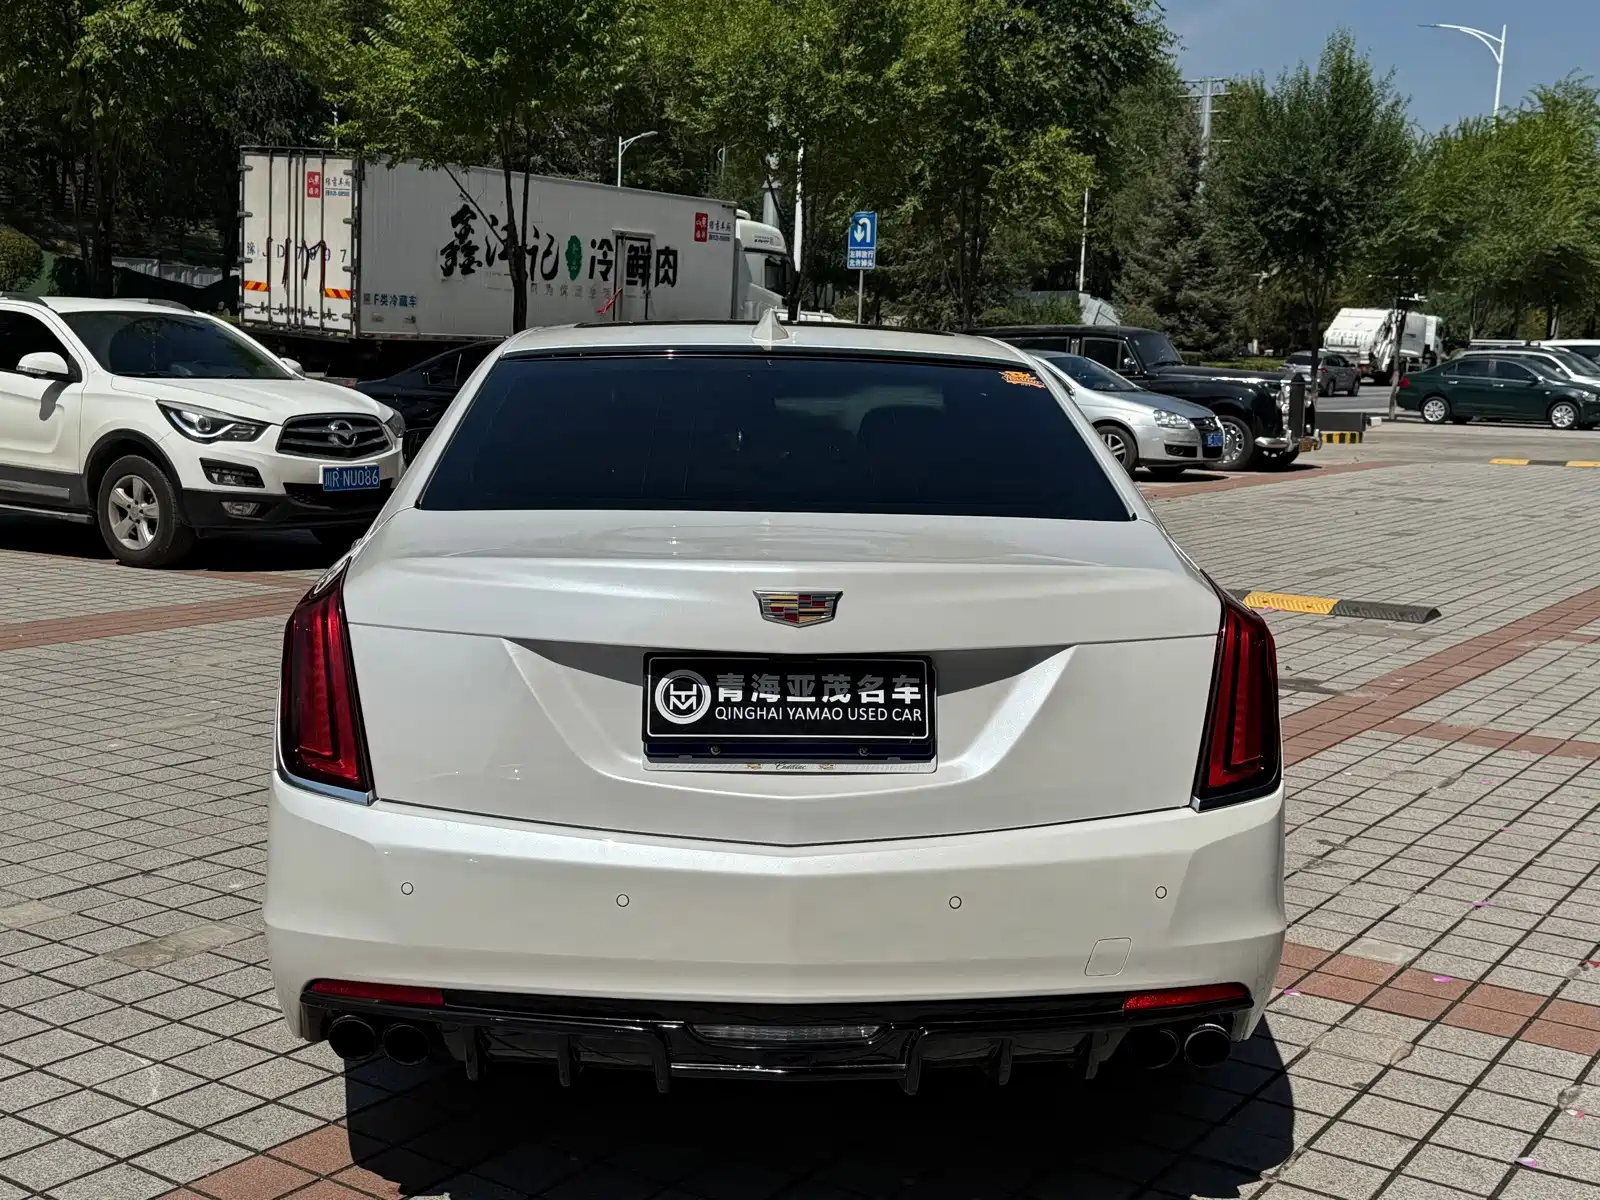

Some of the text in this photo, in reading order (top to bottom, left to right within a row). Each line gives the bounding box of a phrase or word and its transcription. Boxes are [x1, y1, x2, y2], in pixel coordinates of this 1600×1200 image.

[588, 238, 678, 288] 冷鲜肉
[716, 673, 921, 704] 青海亚茂名车
[715, 706, 922, 722] QINGHAI YAMAO USED CAR
